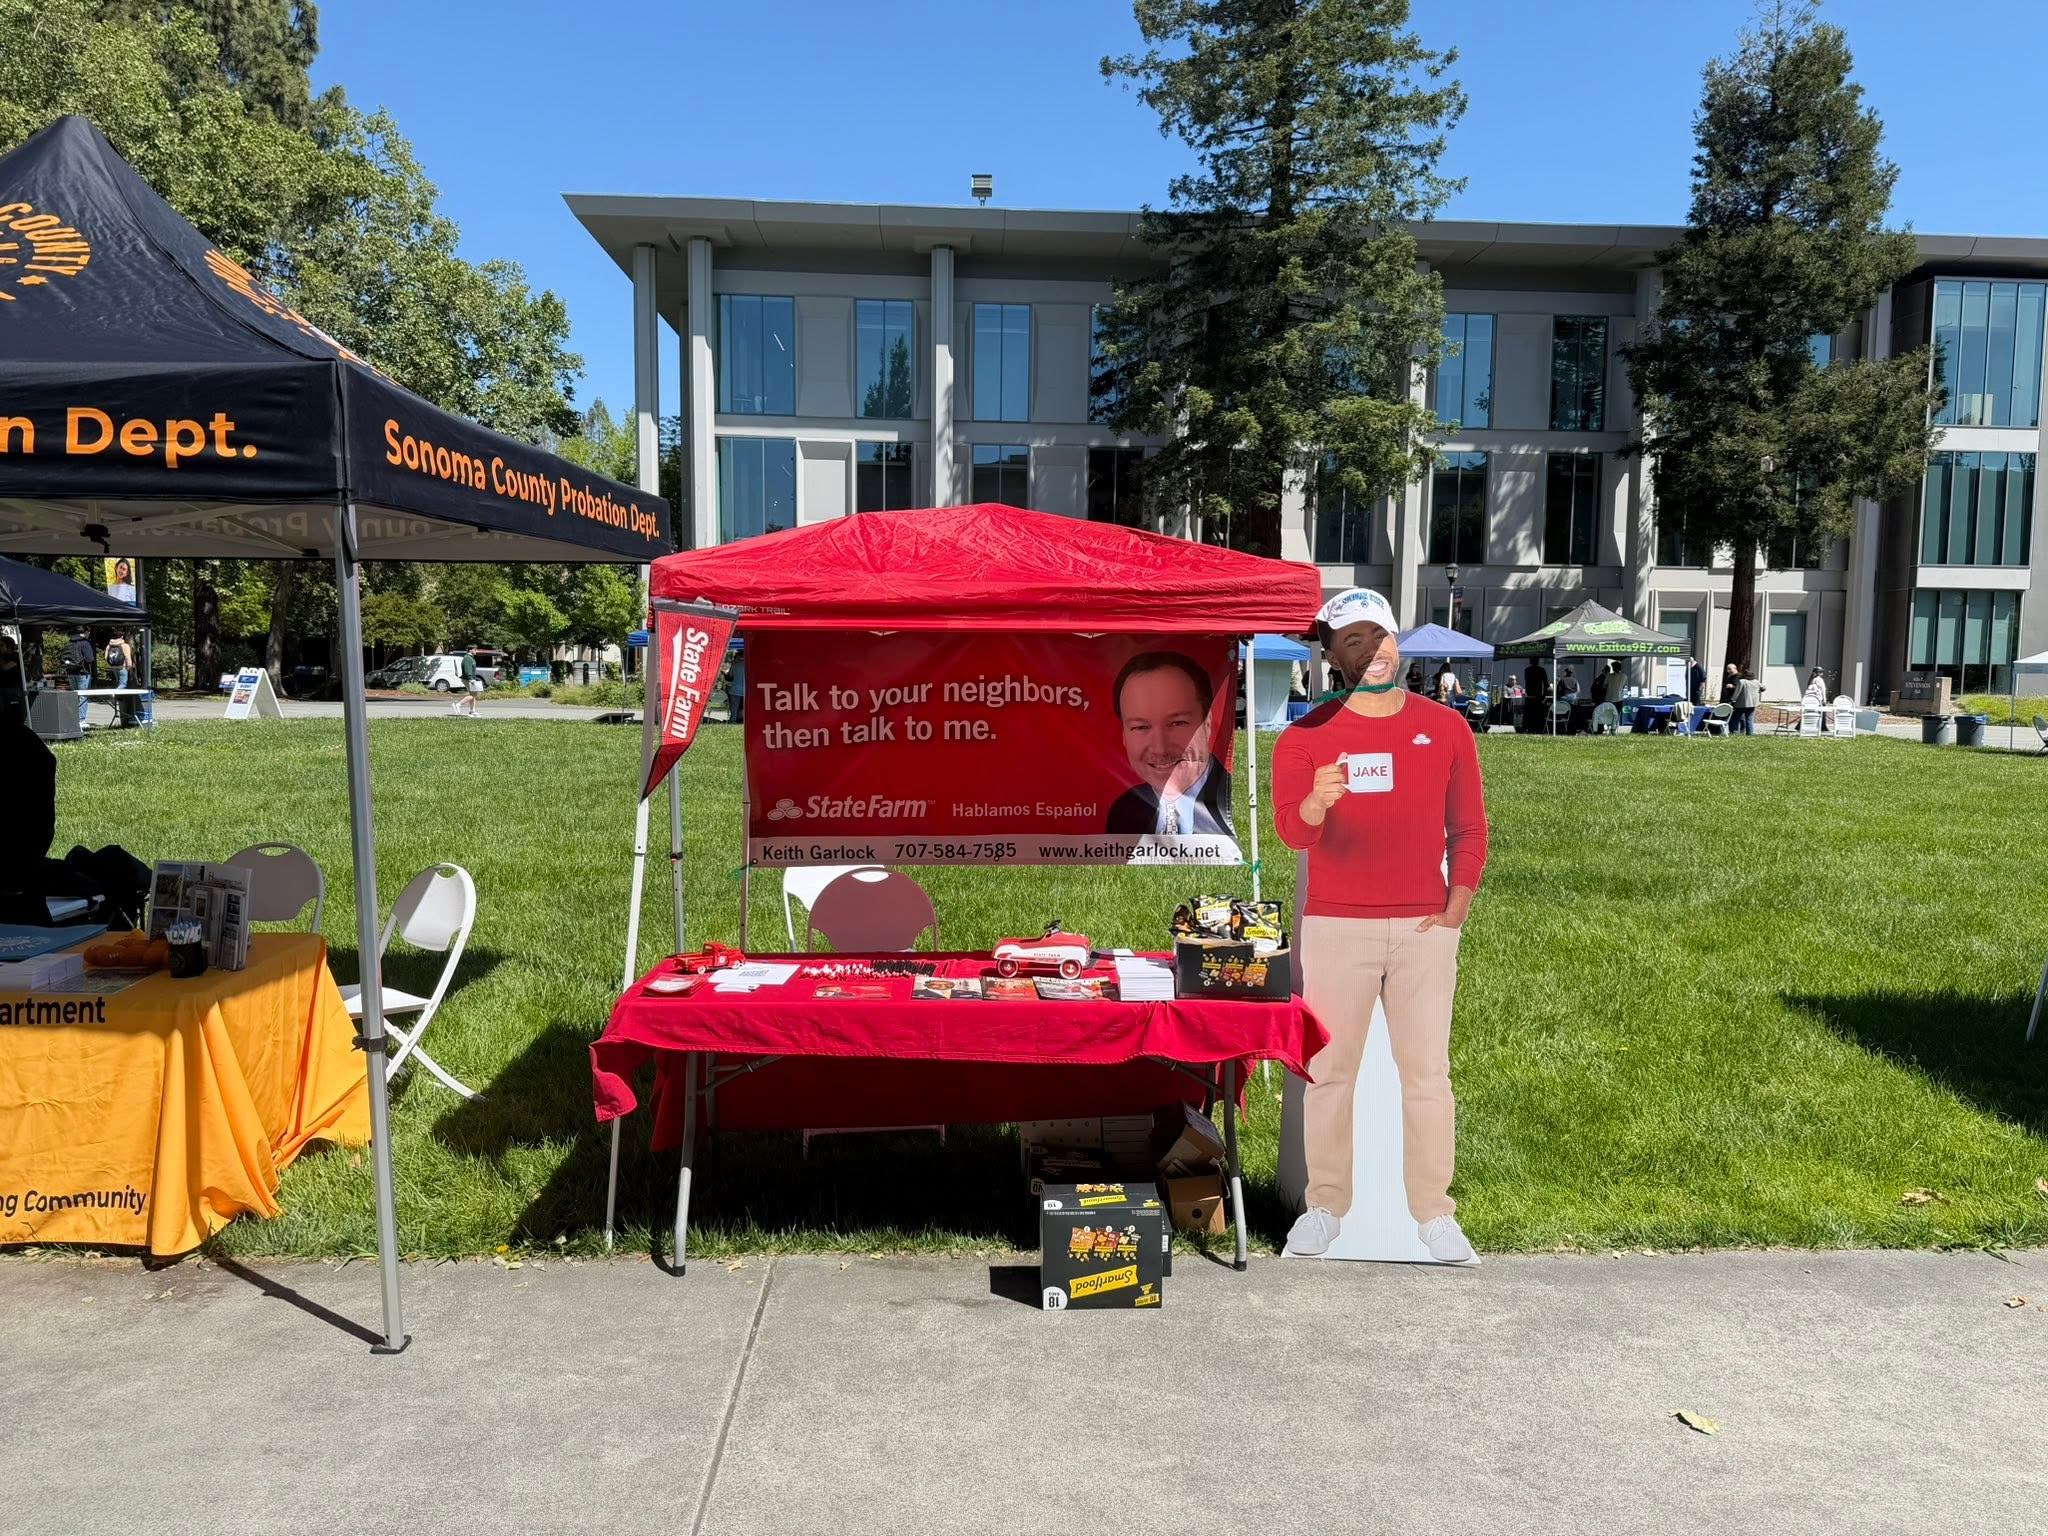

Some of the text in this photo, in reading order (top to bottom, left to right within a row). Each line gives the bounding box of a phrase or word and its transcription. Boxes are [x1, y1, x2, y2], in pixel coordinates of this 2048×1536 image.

[65, 407, 258, 468] Dept.
[384, 418, 661, 542] Sonoma County Probation Dept.
[1566, 641, 1680, 653] www.Exitos987.com
[670, 627, 709, 739] State Farm
[757, 675, 1090, 713] Talk to your neighbors,
[763, 716, 997, 749] then talk to me.
[1353, 765, 1388, 777] JAKE
[952, 801, 1097, 819] Hablamos Español
[763, 843, 1221, 862] Keith Garlock 707-584-7585 www.keithgarlock.net
[24, 1185, 146, 1216] Community
[1075, 1268, 1134, 1295] Smartfood
[1048, 1296, 1060, 1308] 18
